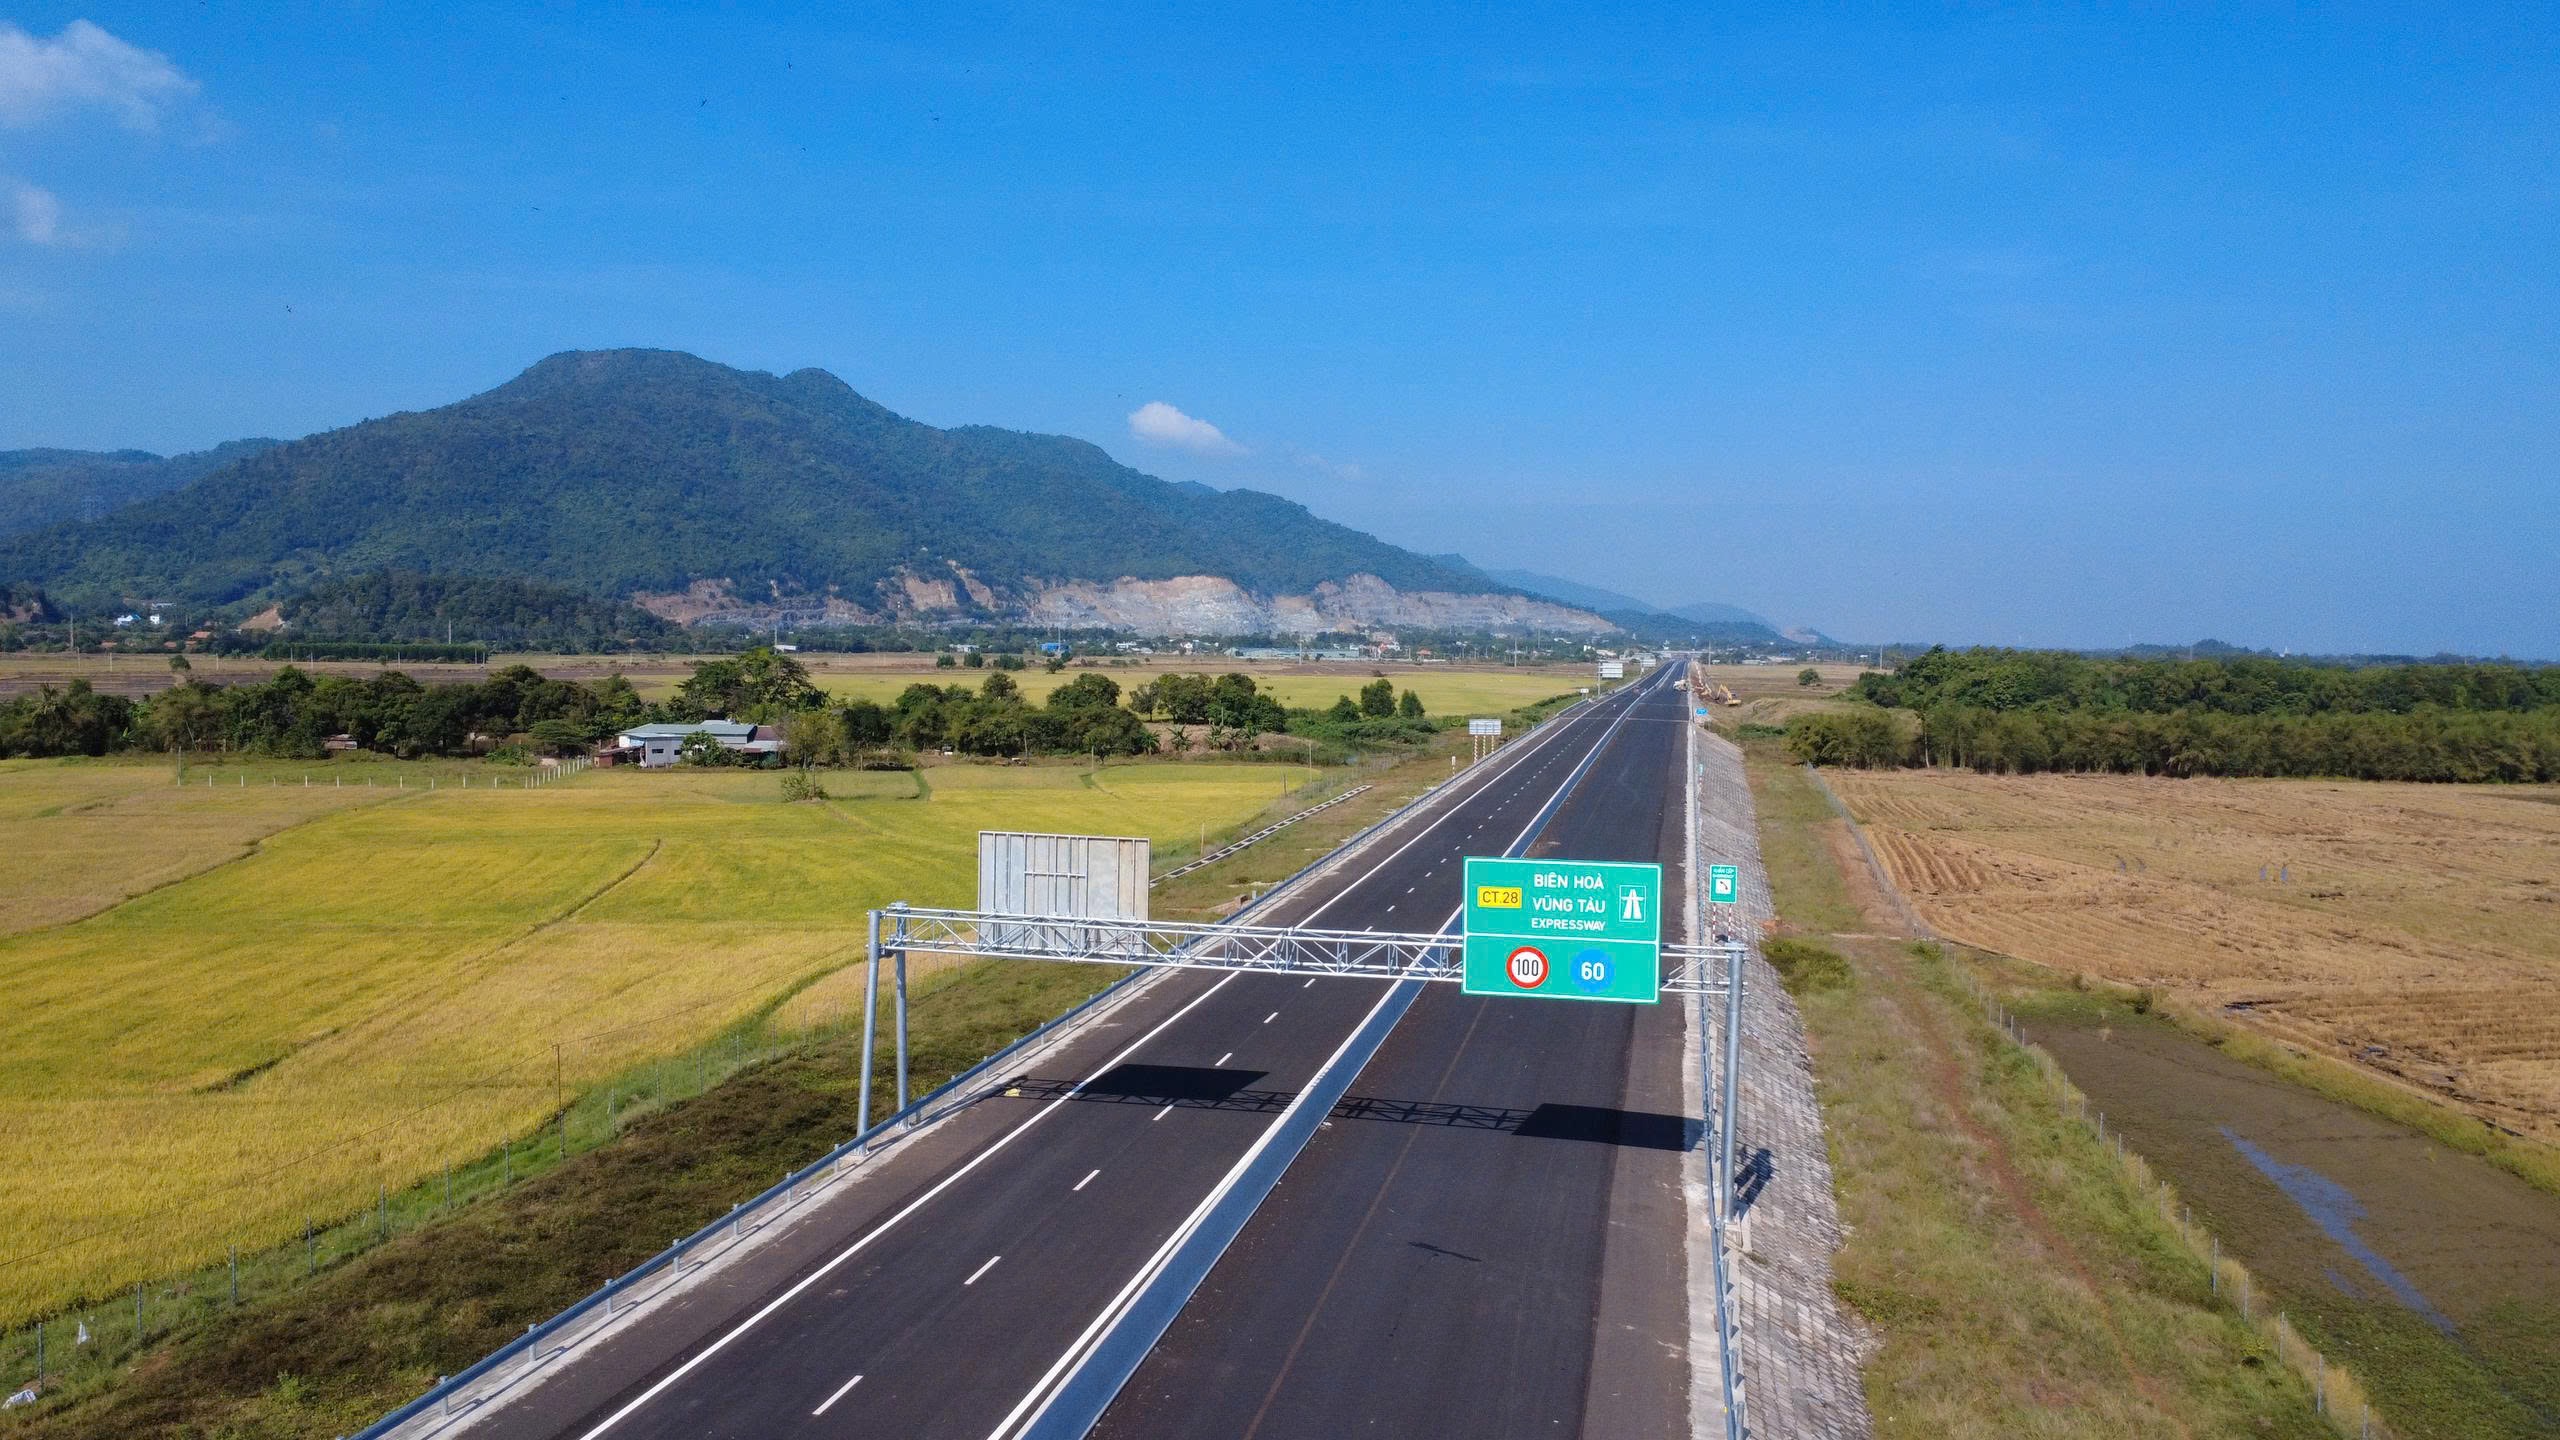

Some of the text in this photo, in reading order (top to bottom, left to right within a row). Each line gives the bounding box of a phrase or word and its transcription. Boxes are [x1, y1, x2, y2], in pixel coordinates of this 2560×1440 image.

[1533, 871, 1604, 890] BIÊN HOÀ
[1482, 890, 1519, 904] CT.28
[1532, 894, 1606, 913] VŨNG TÀU
[1531, 917, 1606, 931] EXPRESSWAY
[1515, 958, 1539, 976] 100
[1581, 961, 1605, 981] 60
